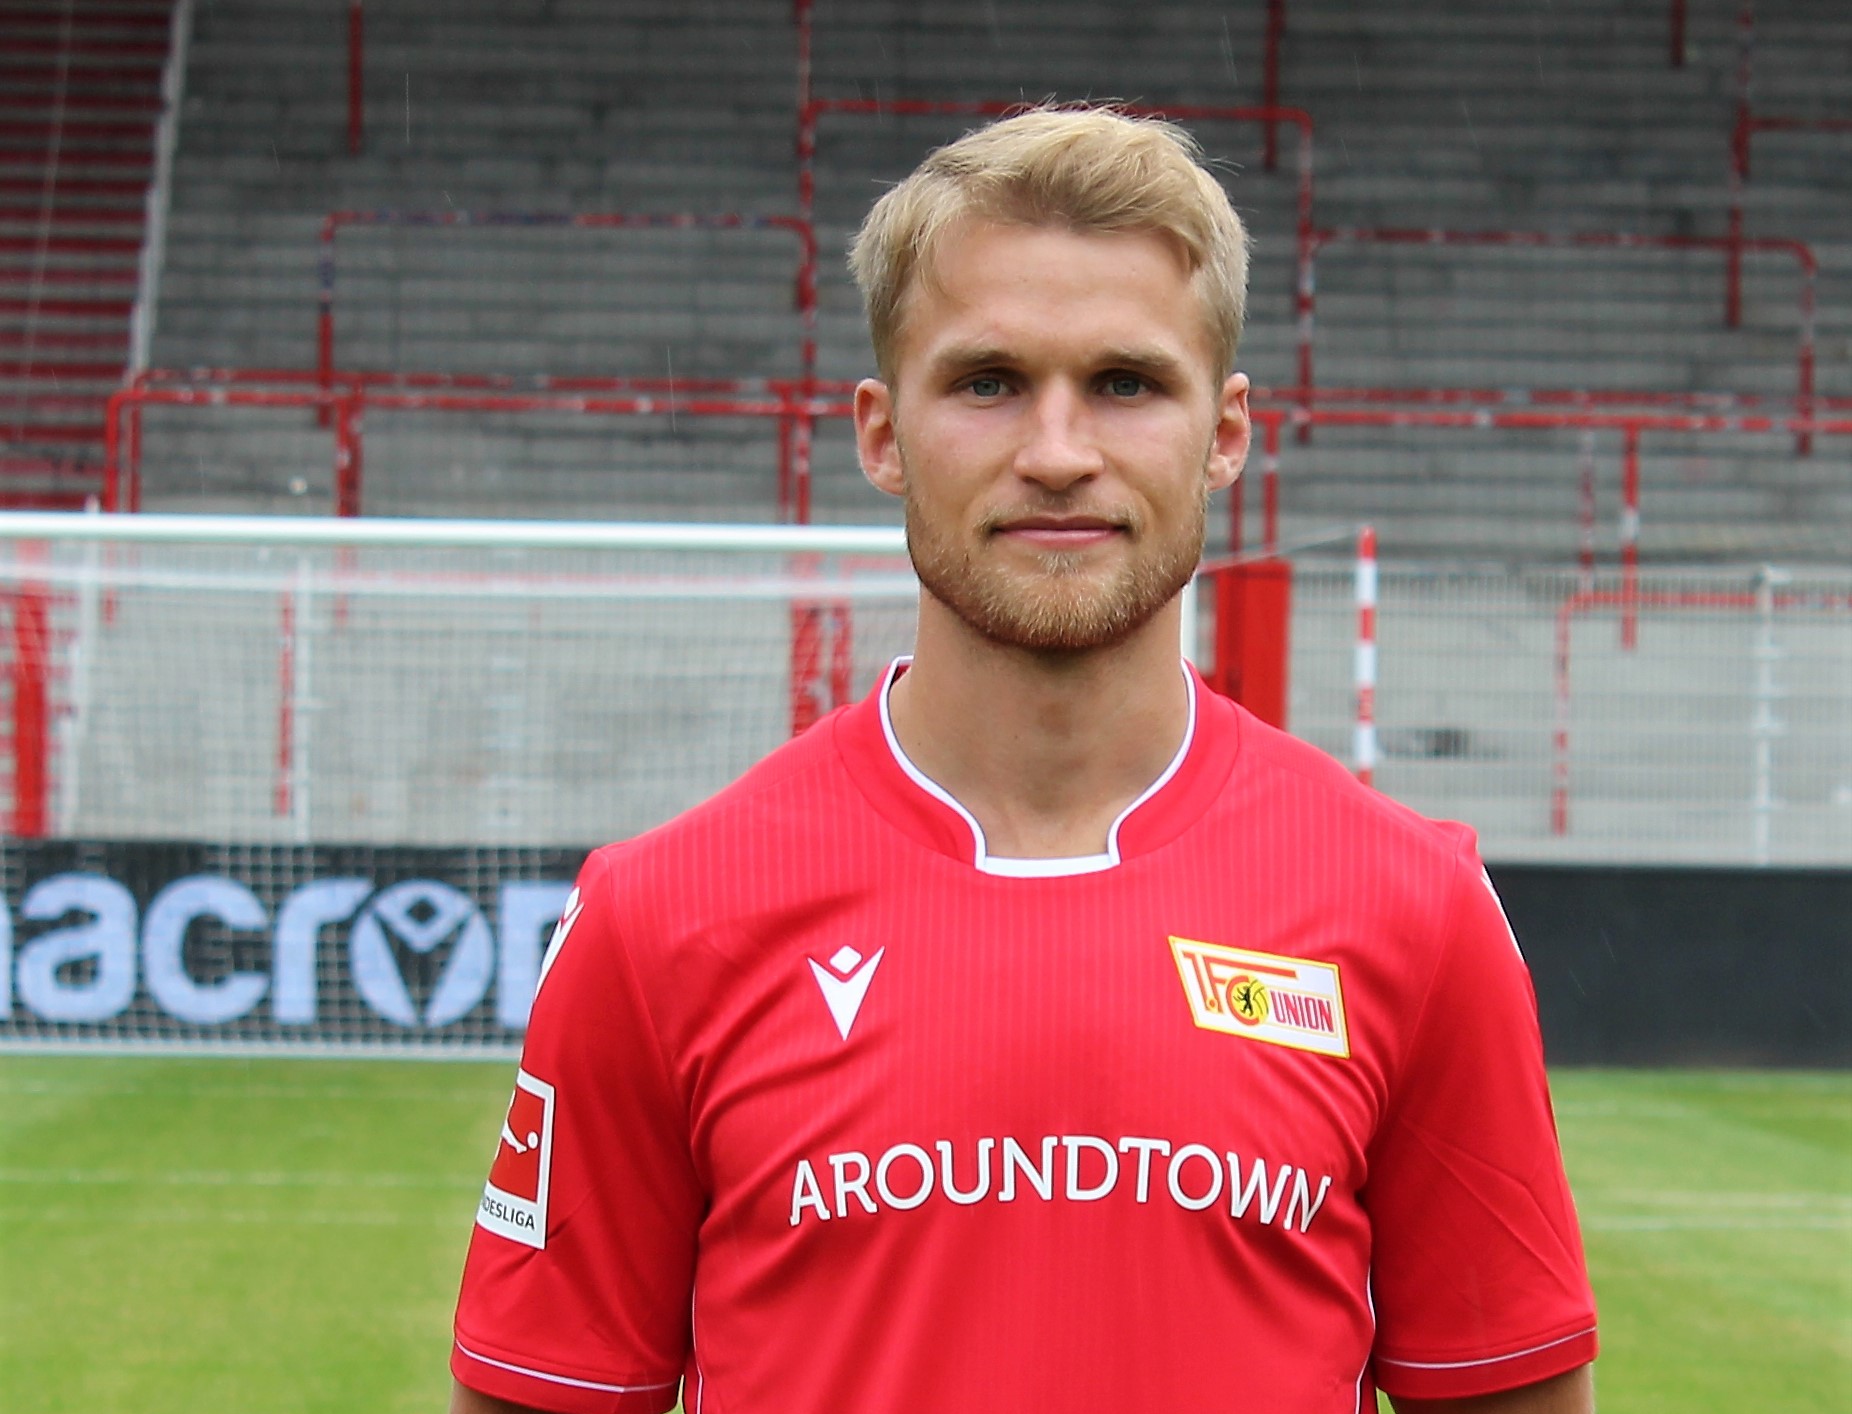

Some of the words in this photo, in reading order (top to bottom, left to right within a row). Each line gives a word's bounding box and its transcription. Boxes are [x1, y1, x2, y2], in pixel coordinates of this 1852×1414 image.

[0, 872, 566, 1028] acro
[1270, 990, 1335, 1034] UNION
[482, 1196, 535, 1231] DESLIGA
[790, 1136, 1332, 1233] AROUNDTOWN
